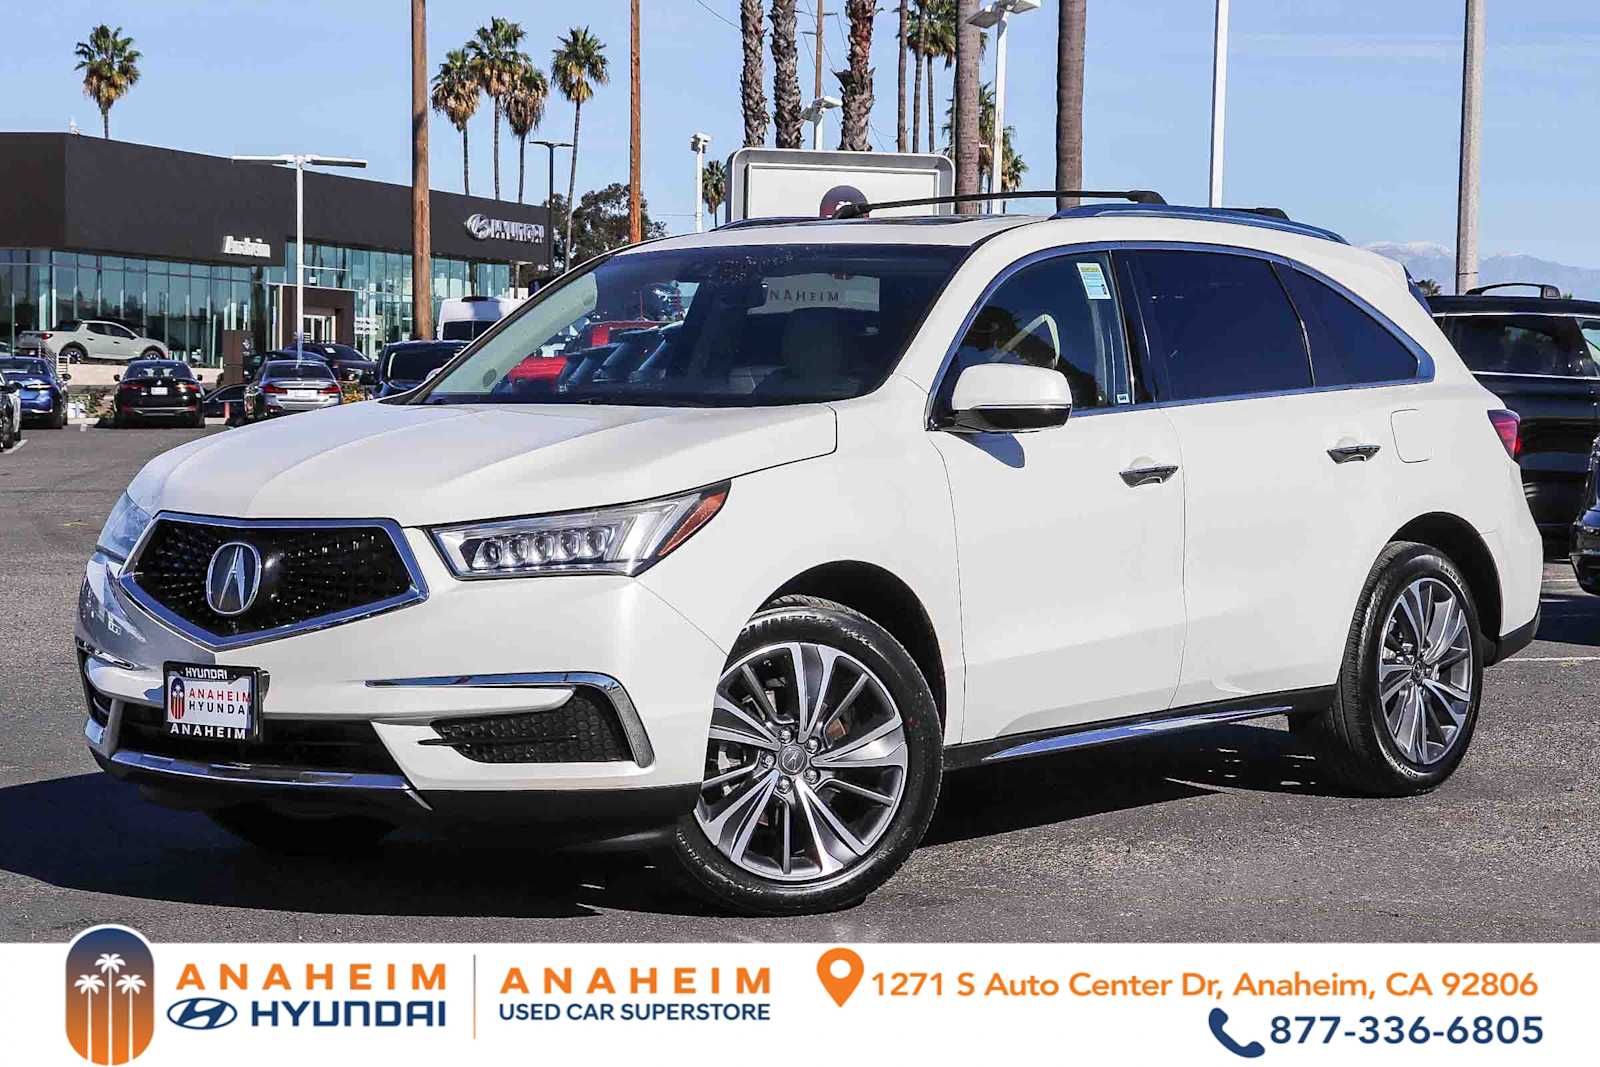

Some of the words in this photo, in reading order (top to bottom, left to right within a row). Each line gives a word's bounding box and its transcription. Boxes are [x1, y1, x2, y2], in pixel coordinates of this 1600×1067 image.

[185, 667, 228, 680] HYUNDAI
[189, 688, 252, 703] ANAHEIM
[170, 723, 246, 740] ANAHEIM
